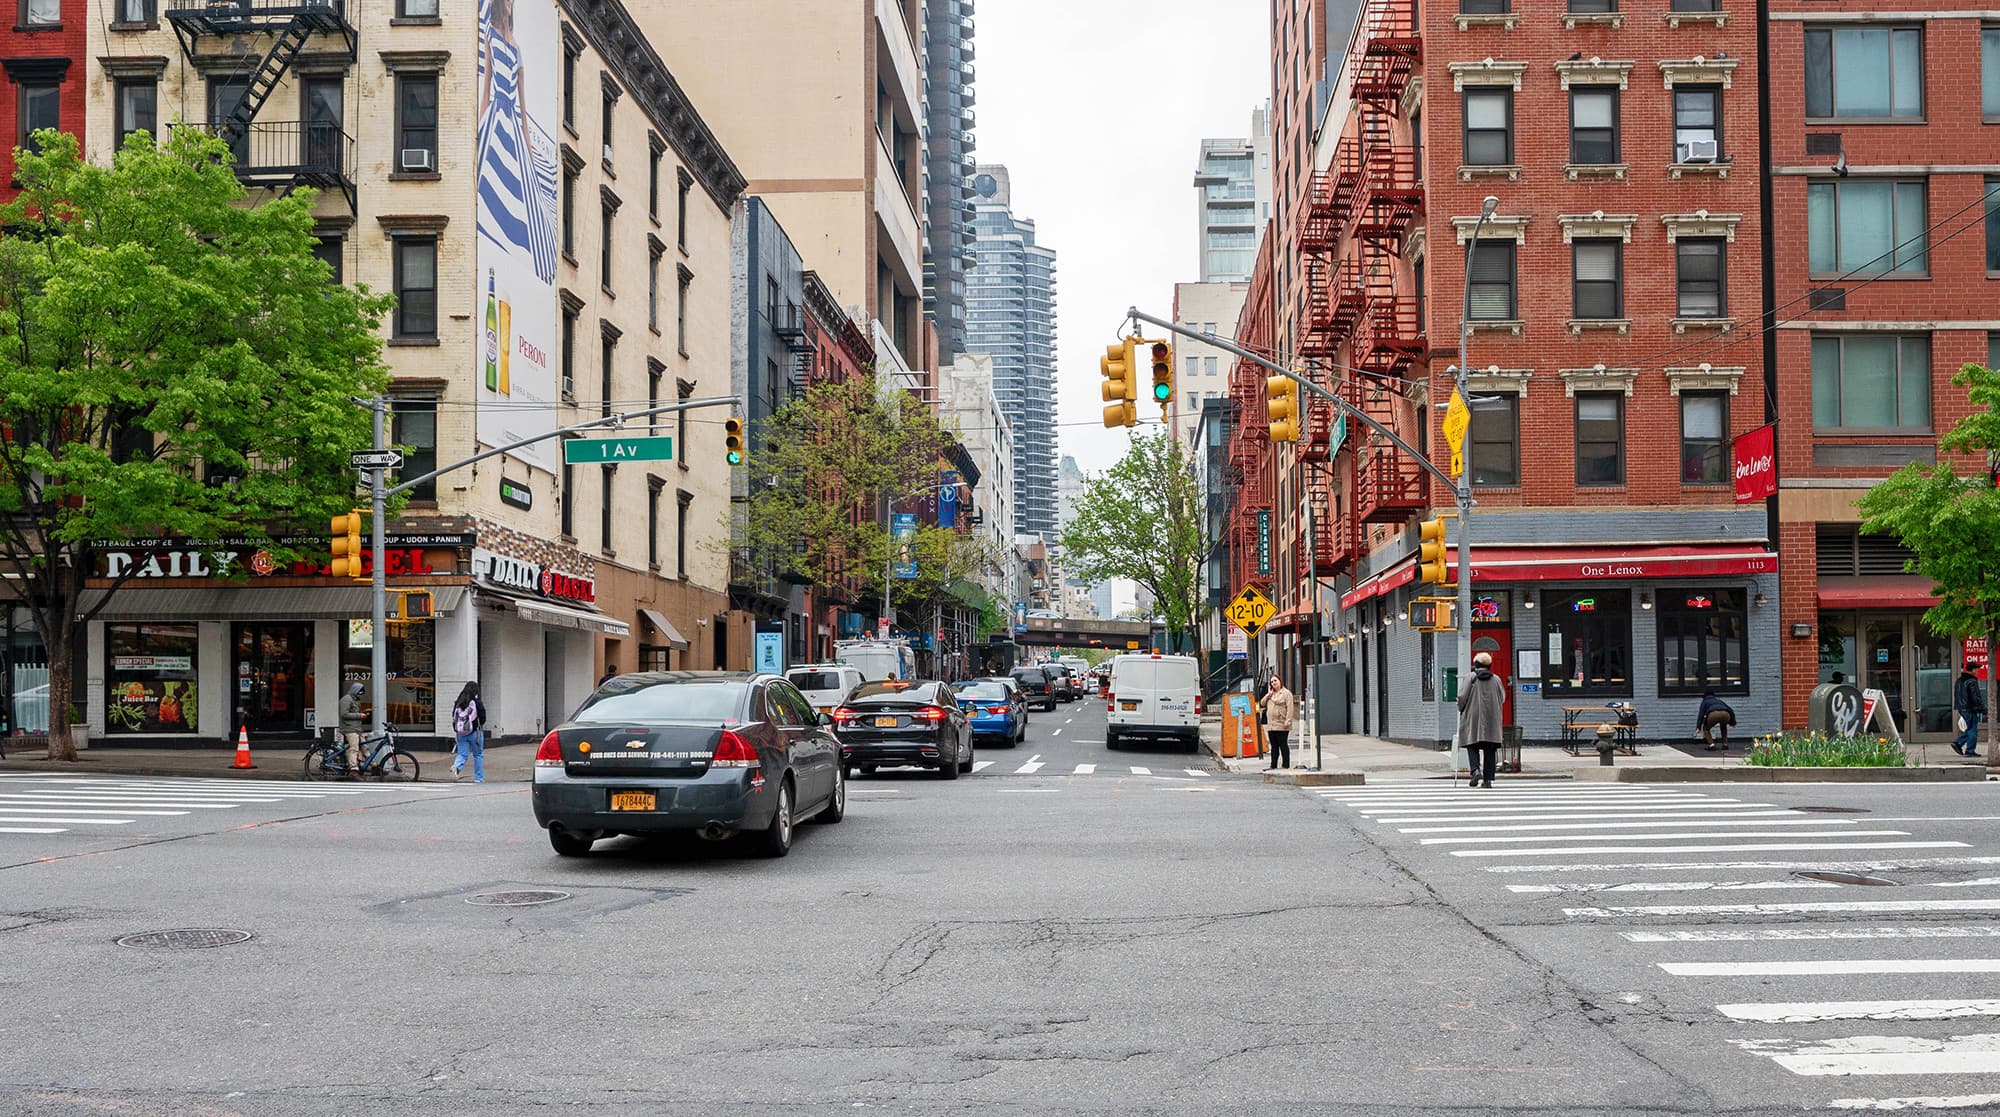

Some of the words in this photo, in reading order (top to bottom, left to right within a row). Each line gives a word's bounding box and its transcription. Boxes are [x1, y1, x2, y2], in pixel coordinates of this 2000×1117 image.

[519, 335, 546, 369] PERONI
[601, 443, 607, 458] 1
[613, 443, 637, 457] Av
[354, 455, 371, 464] ONE
[380, 455, 397, 463] WAY
[141, 539, 173, 547] COFEE
[406, 535, 428, 544] UDON
[435, 535, 462, 544] PANINI
[106, 551, 238, 578] DAILY
[1747, 561, 1765, 569] 1113
[493, 559, 541, 591] DAILY
[1581, 565, 1604, 576] One
[1608, 565, 1643, 576] Lenox
[554, 572, 595, 603] BAGEL
[1425, 607, 1436, 624] 11
[122, 695, 144, 703] Juice
[145, 695, 159, 703] Bar
[616, 795, 652, 806] T678444C
